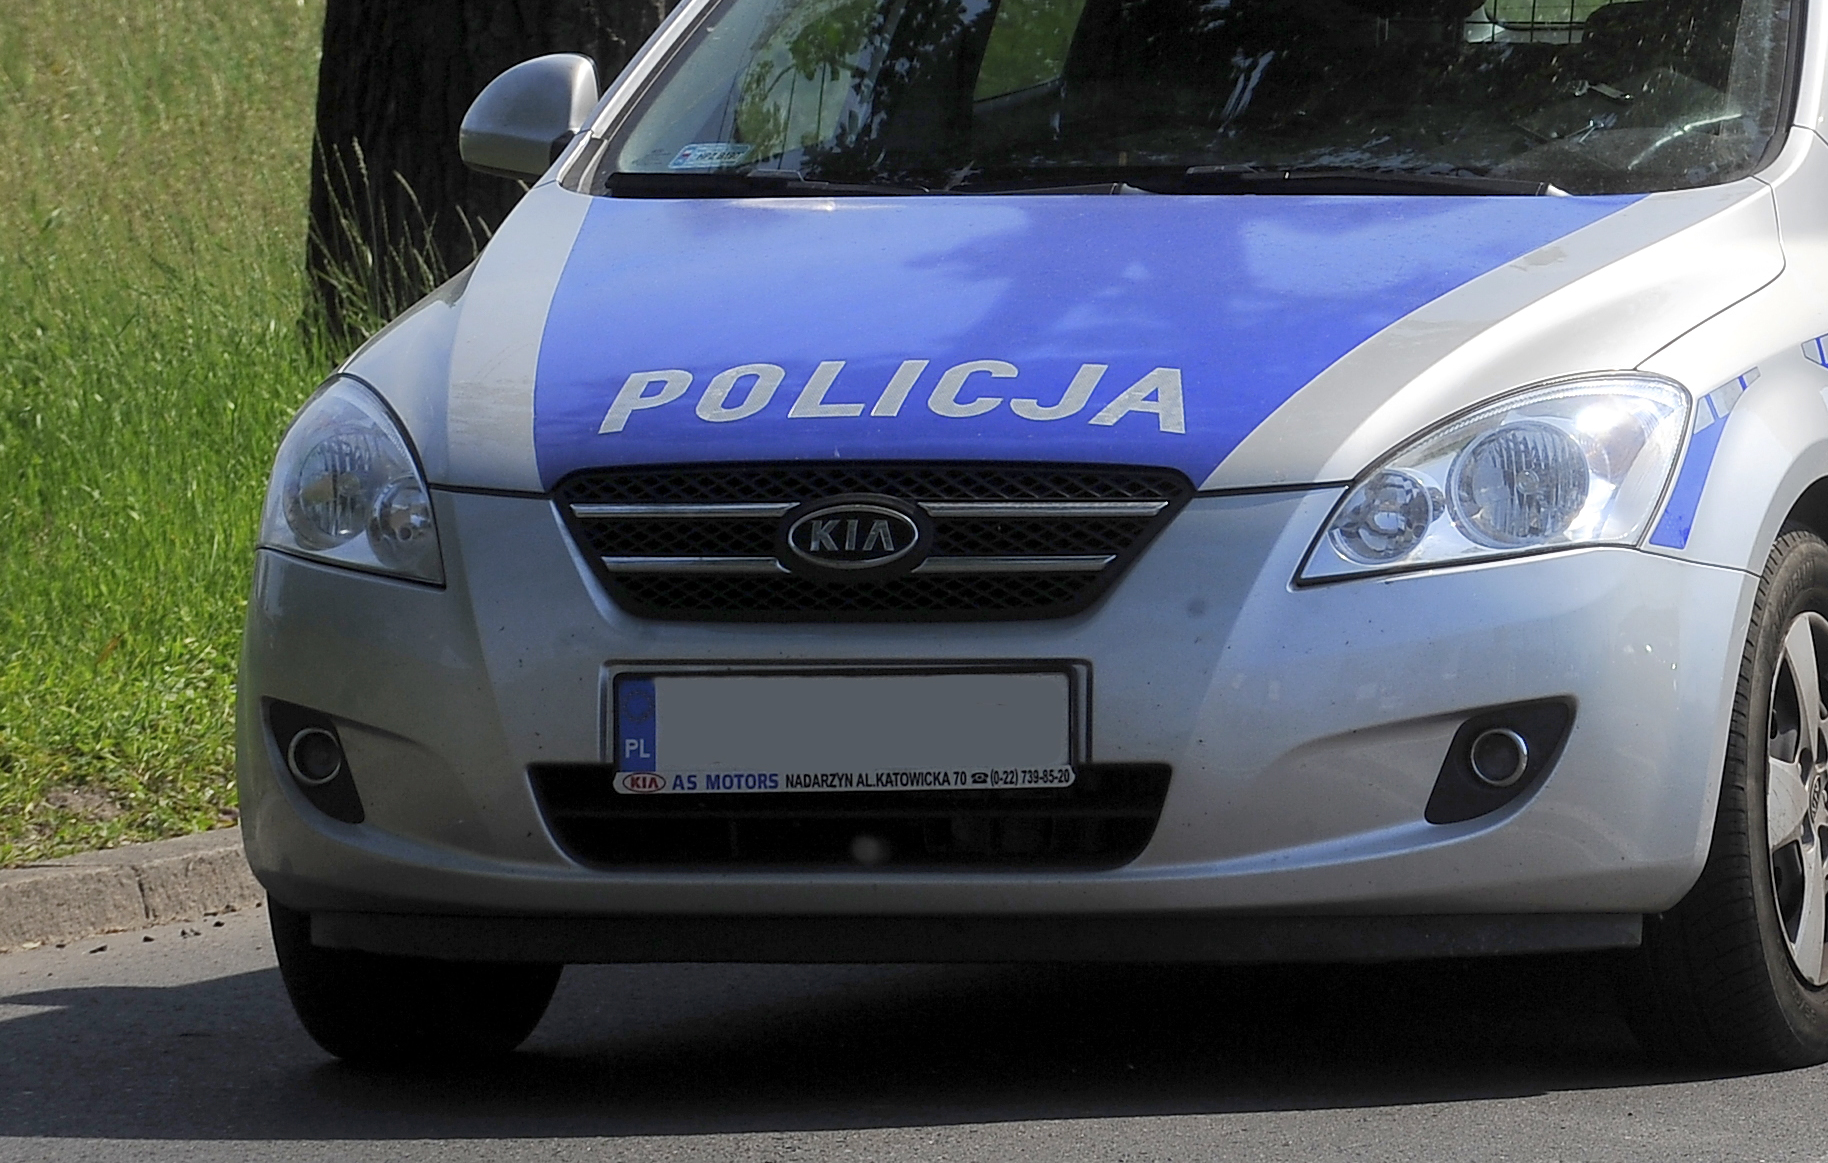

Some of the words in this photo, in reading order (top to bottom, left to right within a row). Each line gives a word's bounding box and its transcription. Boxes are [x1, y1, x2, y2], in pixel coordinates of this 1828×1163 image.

[597, 359, 1187, 435] POLICJA
[809, 518, 896, 553] KIA
[624, 738, 651, 760] PL
[629, 775, 660, 790] KIA
[672, 774, 697, 791] AS
[706, 773, 779, 791] MOTORS
[785, 772, 853, 789] NADARZYN
[953, 770, 967, 786] 70
[990, 768, 1019, 787] (0-22)
[1020, 768, 1070, 785] 739-85-20
